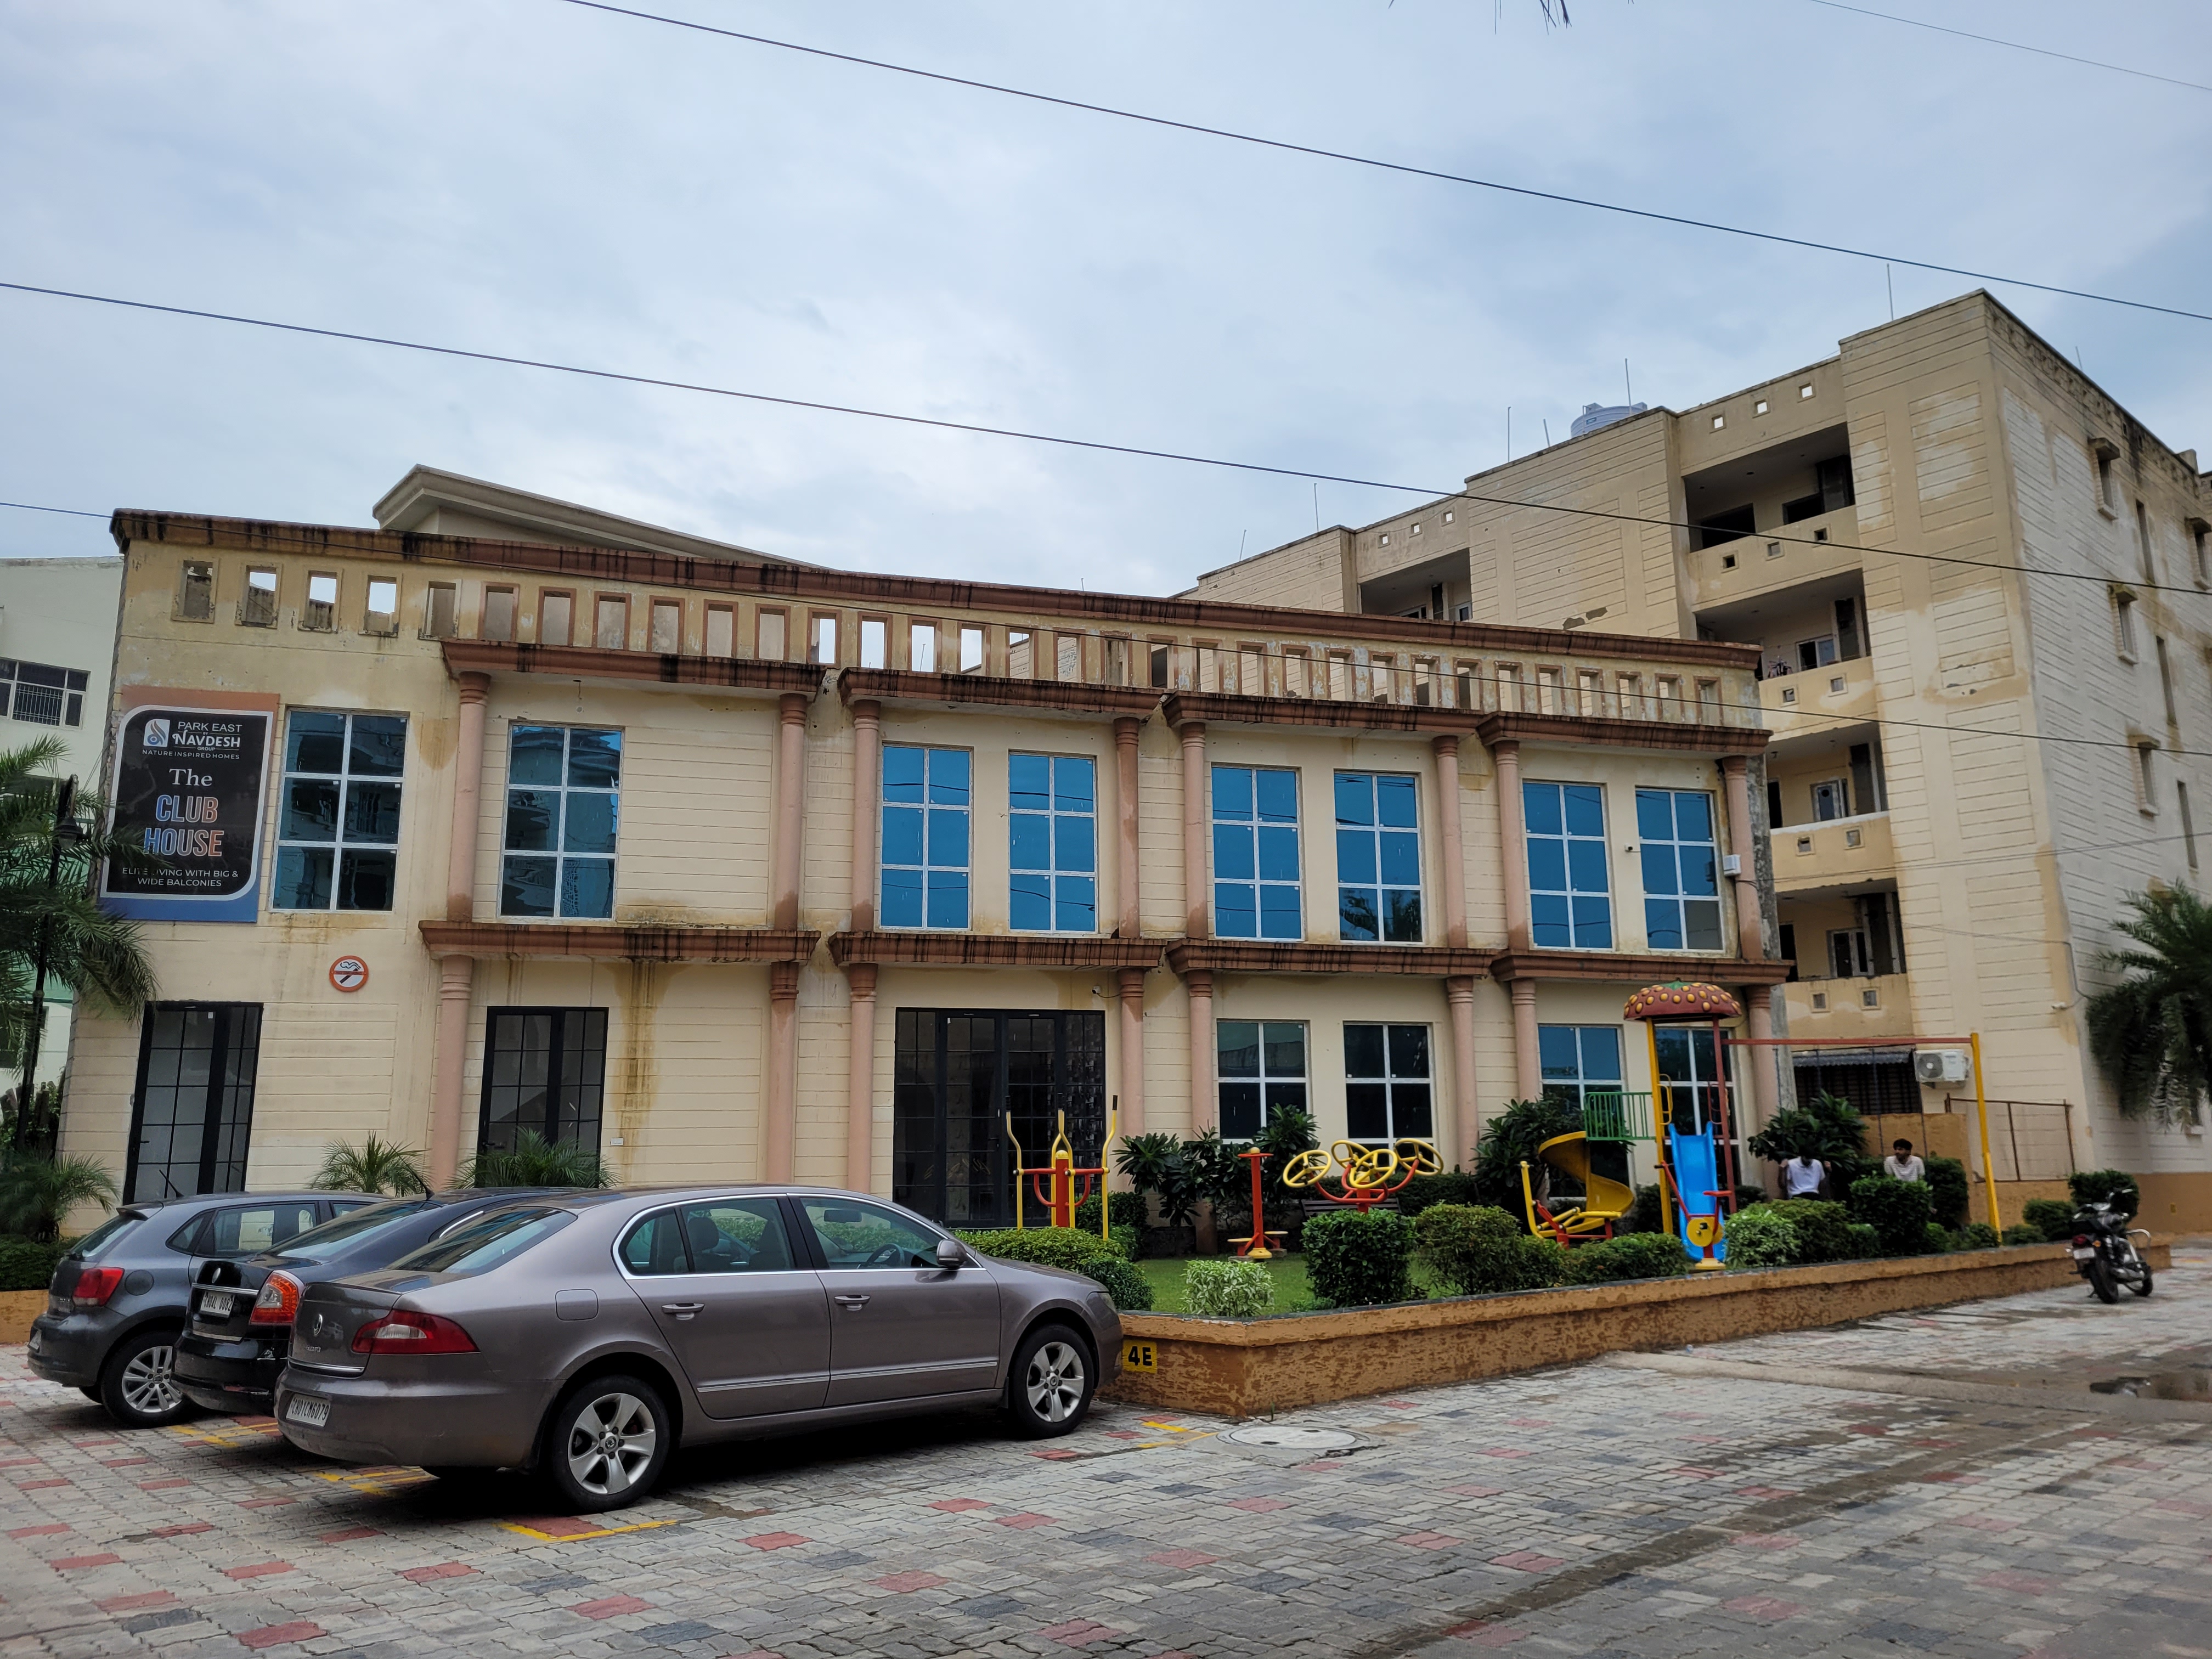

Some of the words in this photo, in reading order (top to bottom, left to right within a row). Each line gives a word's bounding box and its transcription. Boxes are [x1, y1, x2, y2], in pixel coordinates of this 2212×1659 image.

[178, 721, 209, 731] PARK
[212, 723, 242, 732] EAST
[172, 730, 241, 747] NAVDESH
[168, 768, 213, 787] The
[155, 794, 219, 823] CLUB
[143, 827, 225, 857] HOUSE
[137, 877, 164, 885] WIDE
[151, 868, 183, 877] IVING
[1128, 1346, 1153, 1366] 4E
